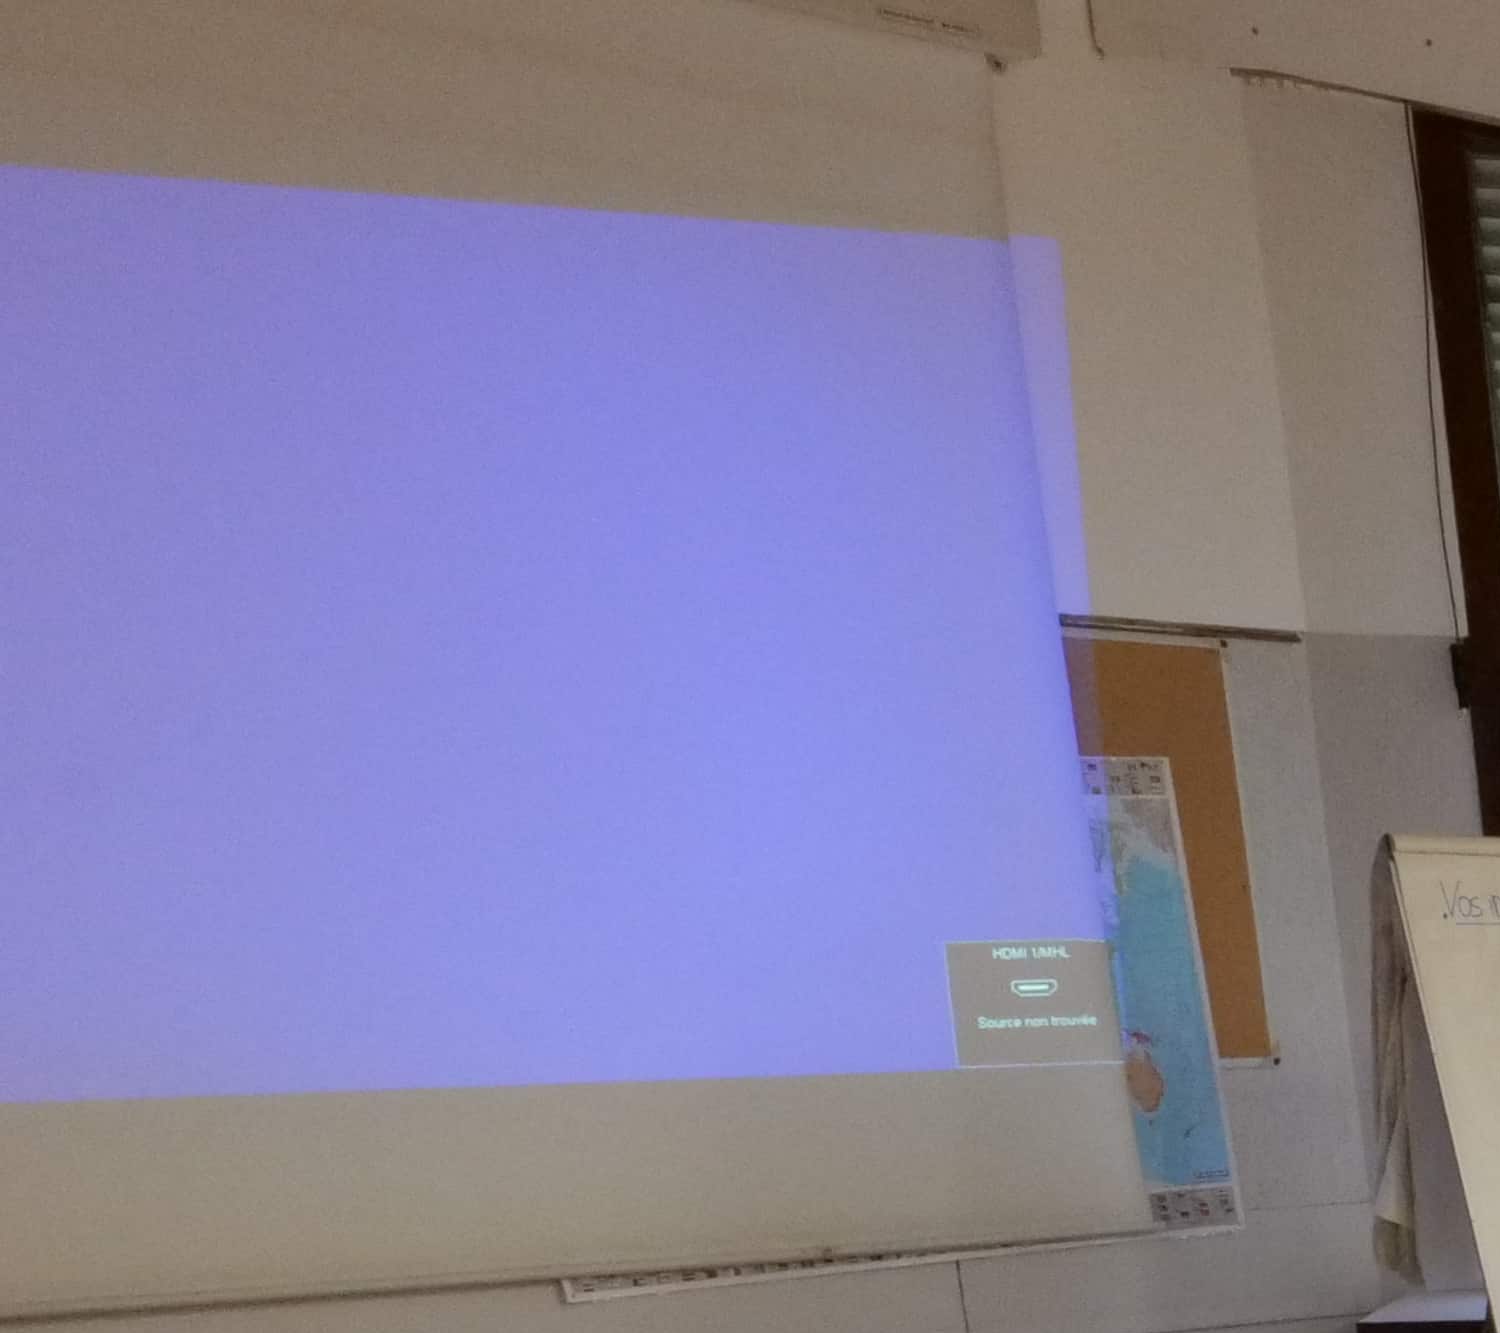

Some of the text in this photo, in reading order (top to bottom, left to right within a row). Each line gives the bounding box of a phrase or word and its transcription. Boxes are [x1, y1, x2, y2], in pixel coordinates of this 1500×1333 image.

[992, 946, 1027, 960] HDMI
[977, 1014, 1098, 1029] Source non trouvée
